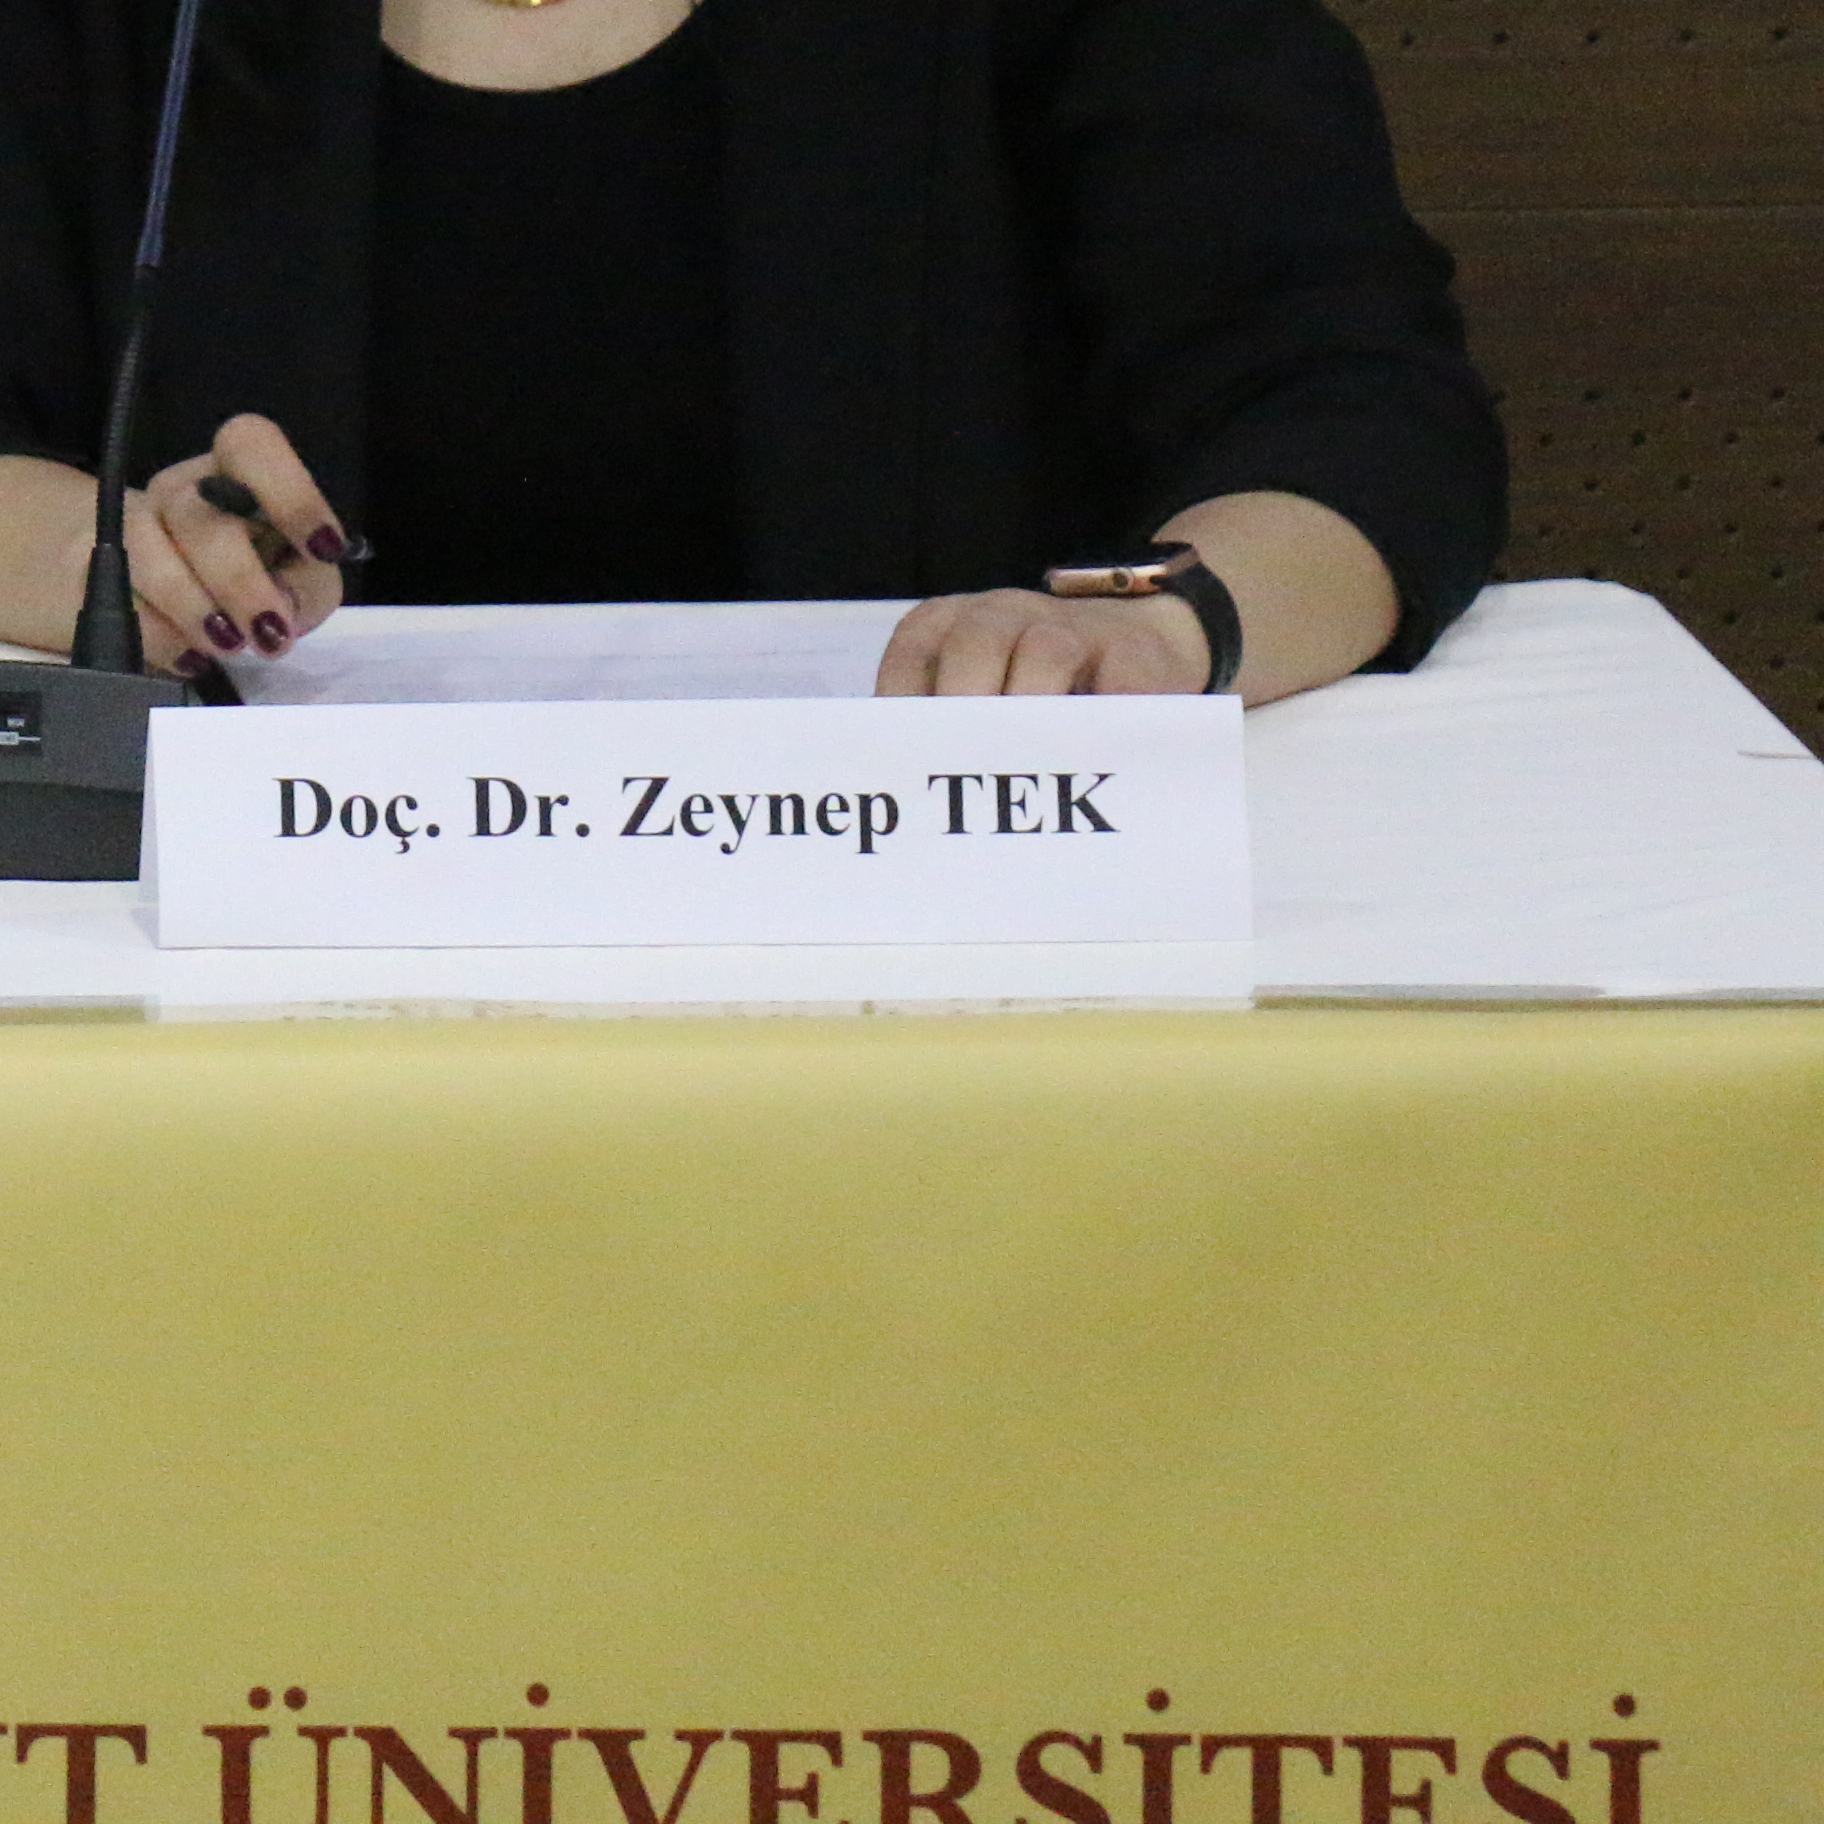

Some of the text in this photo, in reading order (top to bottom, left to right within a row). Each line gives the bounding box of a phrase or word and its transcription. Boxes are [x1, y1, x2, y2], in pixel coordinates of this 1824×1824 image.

[274, 772, 1118, 855] Doç. Dr. Zeynep TEK
[202, 1682, 1662, 1824] ÜNİVERSİTESİ
